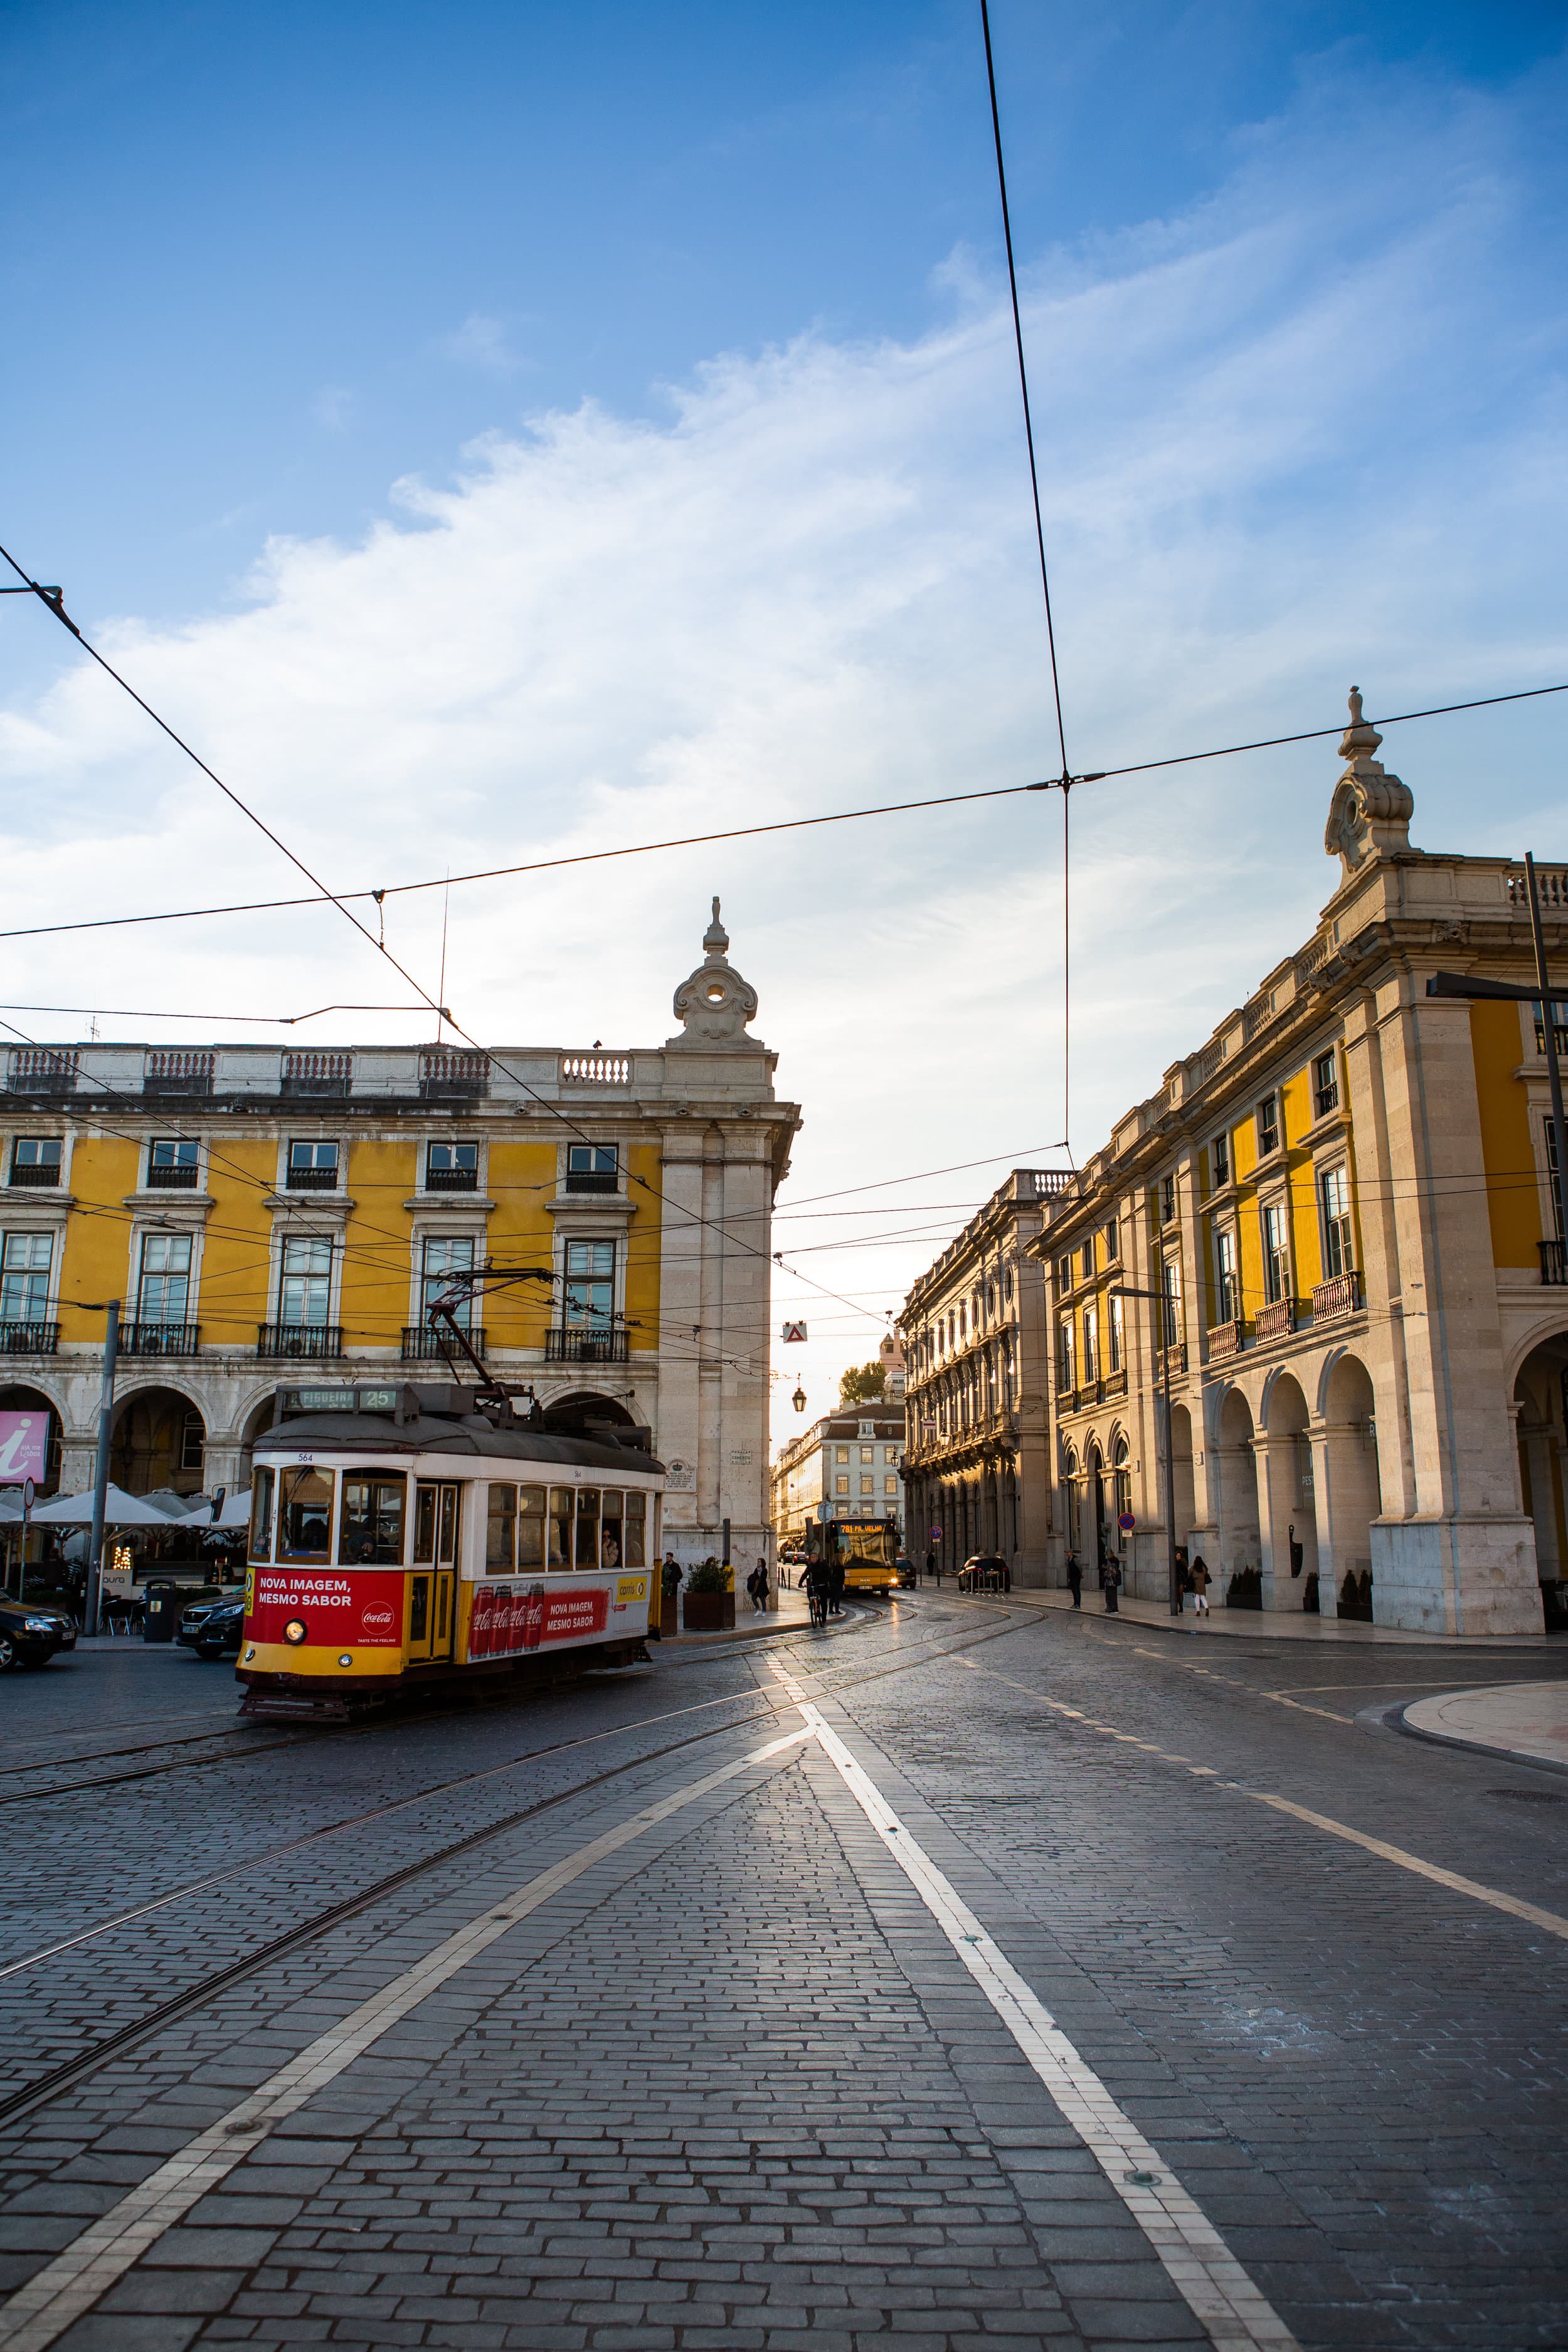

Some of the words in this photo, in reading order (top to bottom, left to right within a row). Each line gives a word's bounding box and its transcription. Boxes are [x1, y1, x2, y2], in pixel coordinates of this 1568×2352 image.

[367, 1391, 389, 1406] 25
[298, 1453, 313, 1461] 564
[840, 1525, 852, 1534] 781
[260, 1577, 287, 1589] NOVA
[290, 1579, 351, 1592] IMAGEM,
[259, 1592, 299, 1605] MESMO
[302, 1596, 351, 1606] SABOR
[550, 1604, 567, 1616] NOVA
[568, 1601, 594, 1614] IMAGEM,
[547, 1619, 571, 1631] MESMO
[573, 1616, 593, 1628] SABOR
